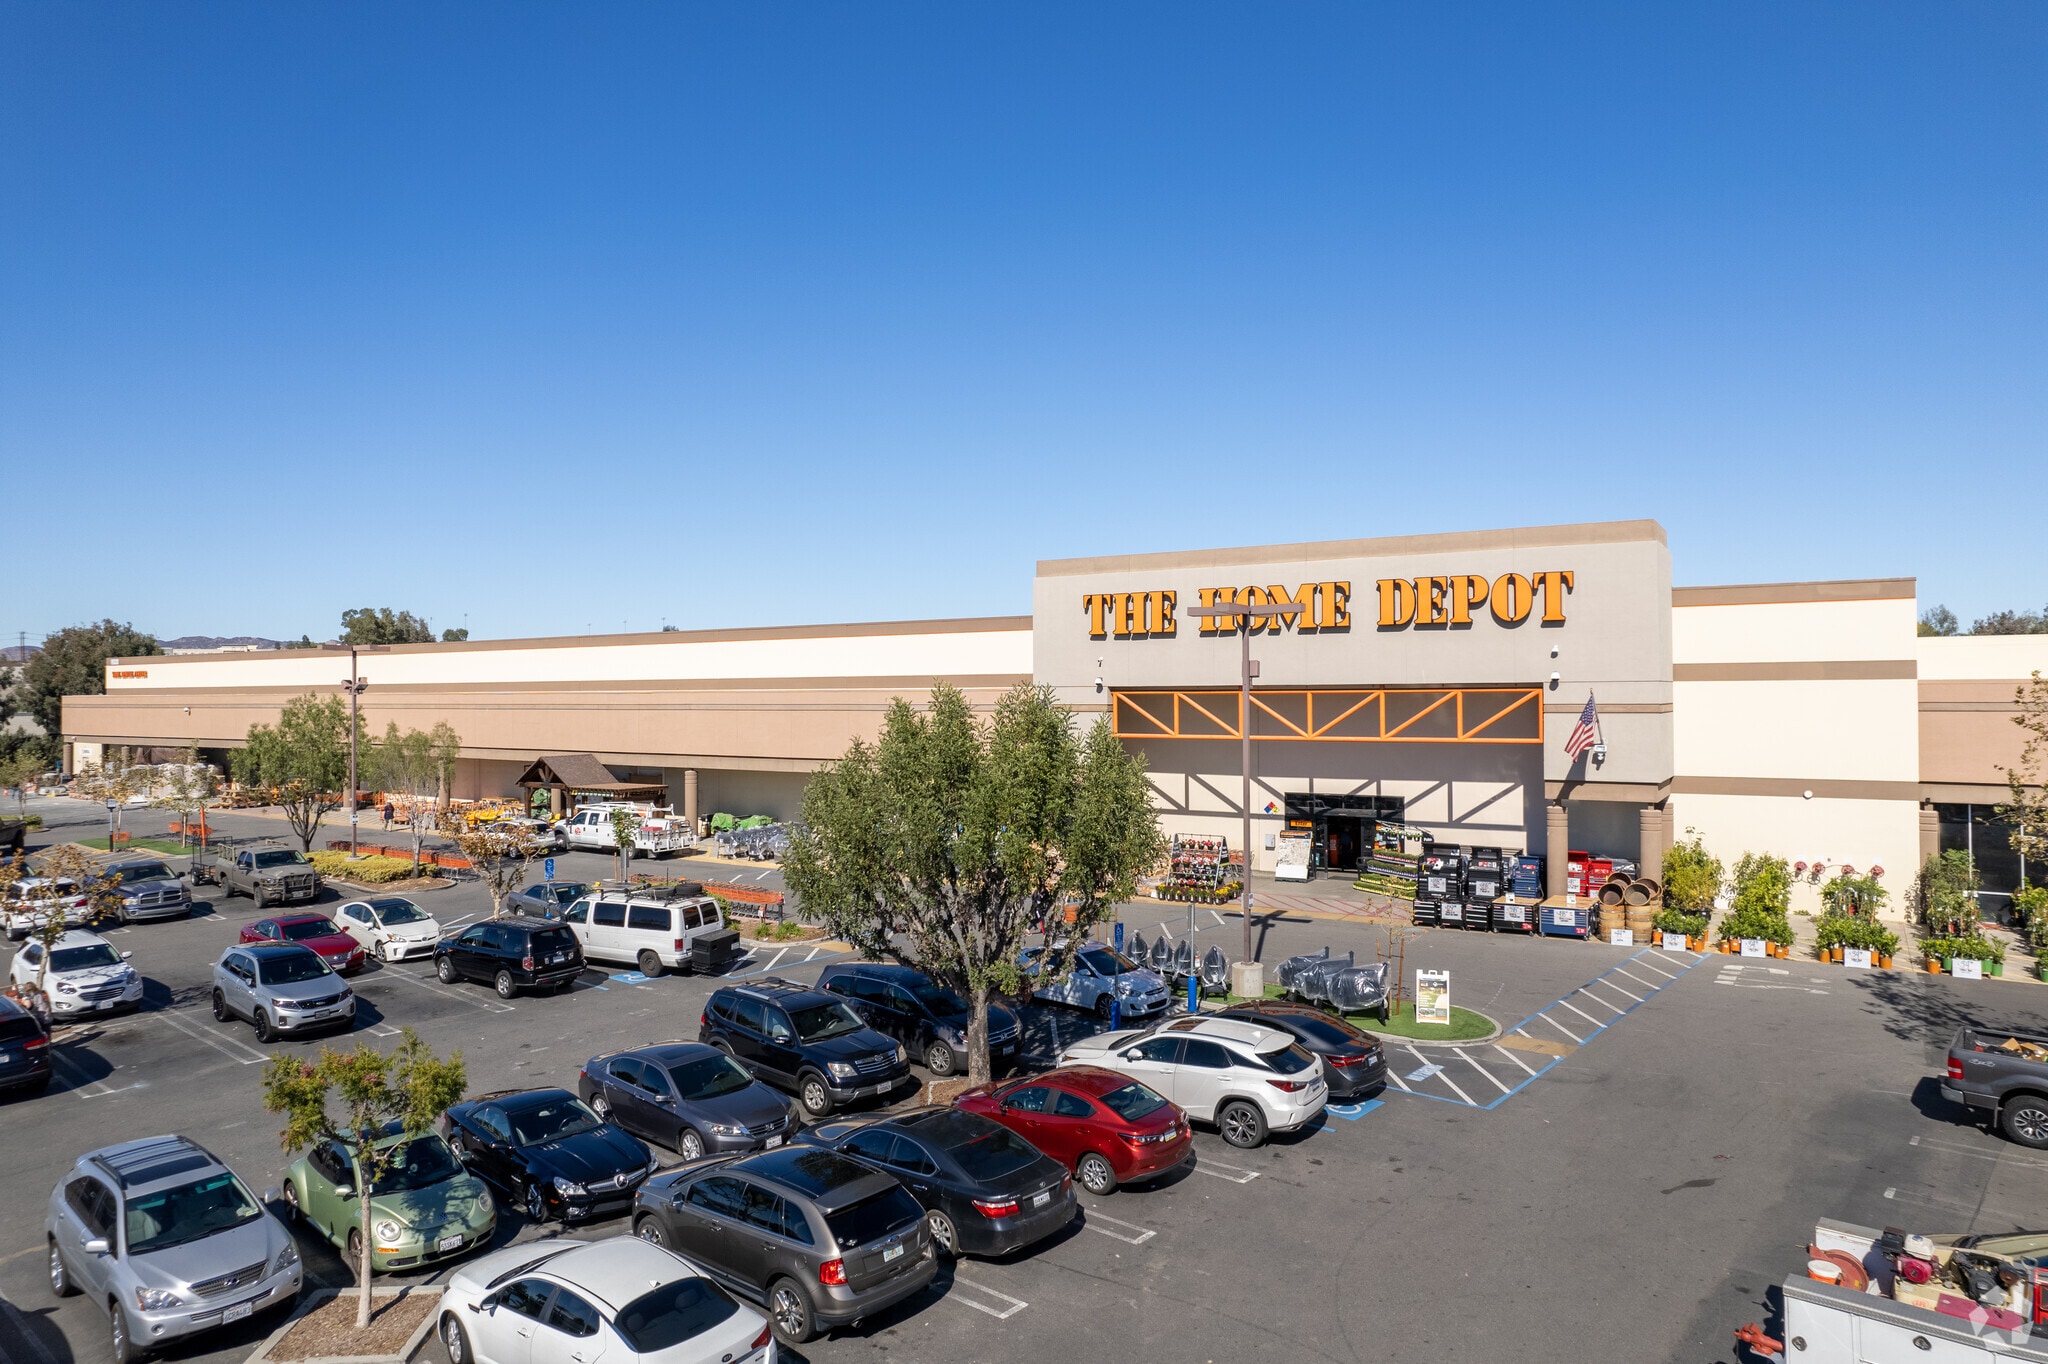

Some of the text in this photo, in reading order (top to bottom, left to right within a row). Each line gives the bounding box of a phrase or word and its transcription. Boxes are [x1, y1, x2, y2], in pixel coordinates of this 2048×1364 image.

[1083, 570, 1574, 637] THE HOME DEPOT
